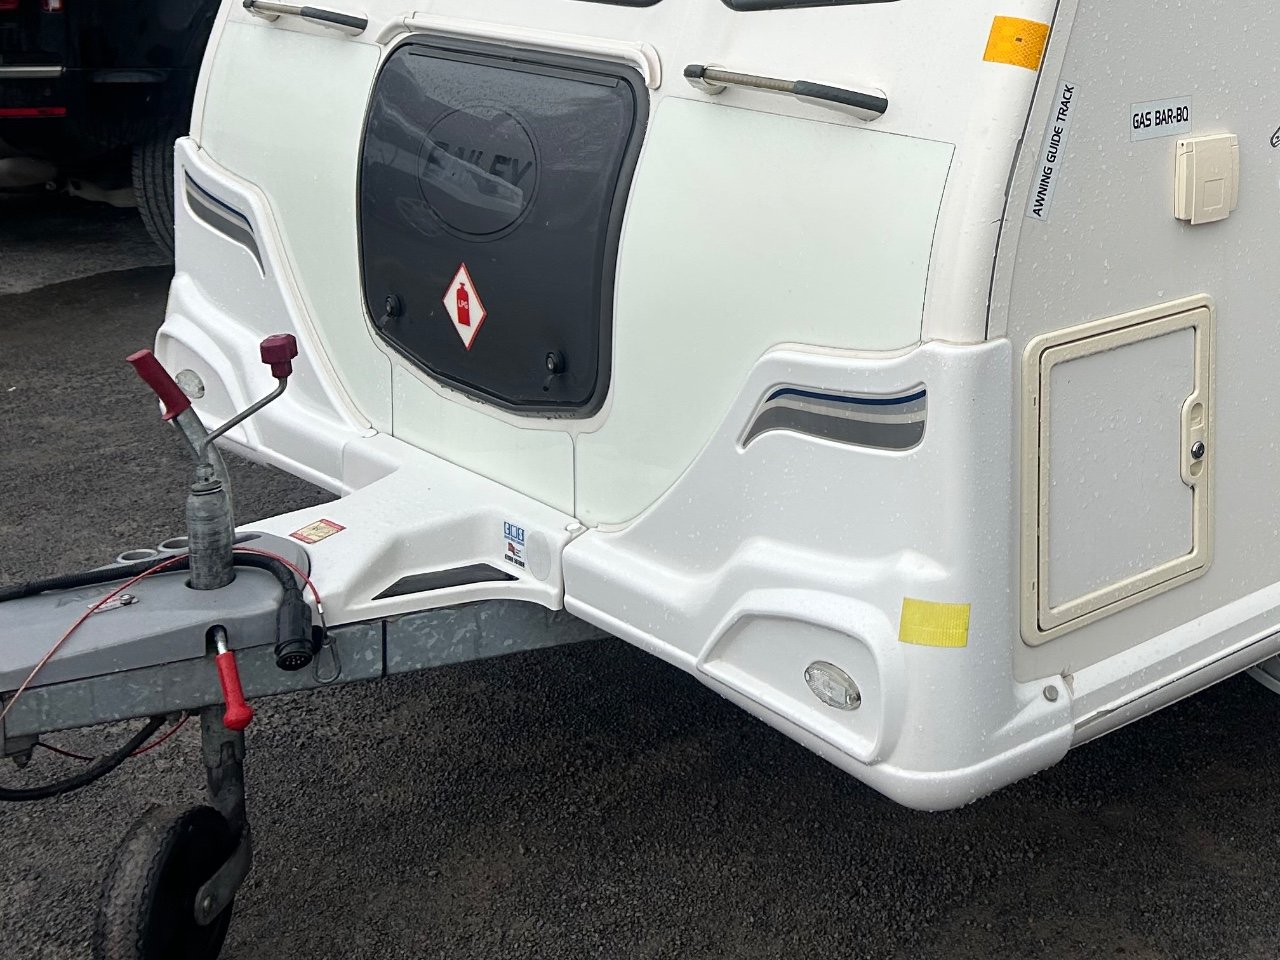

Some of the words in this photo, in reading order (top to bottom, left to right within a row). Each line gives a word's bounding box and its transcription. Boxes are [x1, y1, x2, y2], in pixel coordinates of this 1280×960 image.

[1132, 111, 1152, 130] GAS
[1154, 105, 1189, 127] BAR-BQ
[1032, 165, 1053, 218] AWNING
[1046, 125, 1064, 163] GUIDE
[1056, 84, 1075, 123] TRACK
[457, 299, 469, 310] LPG
